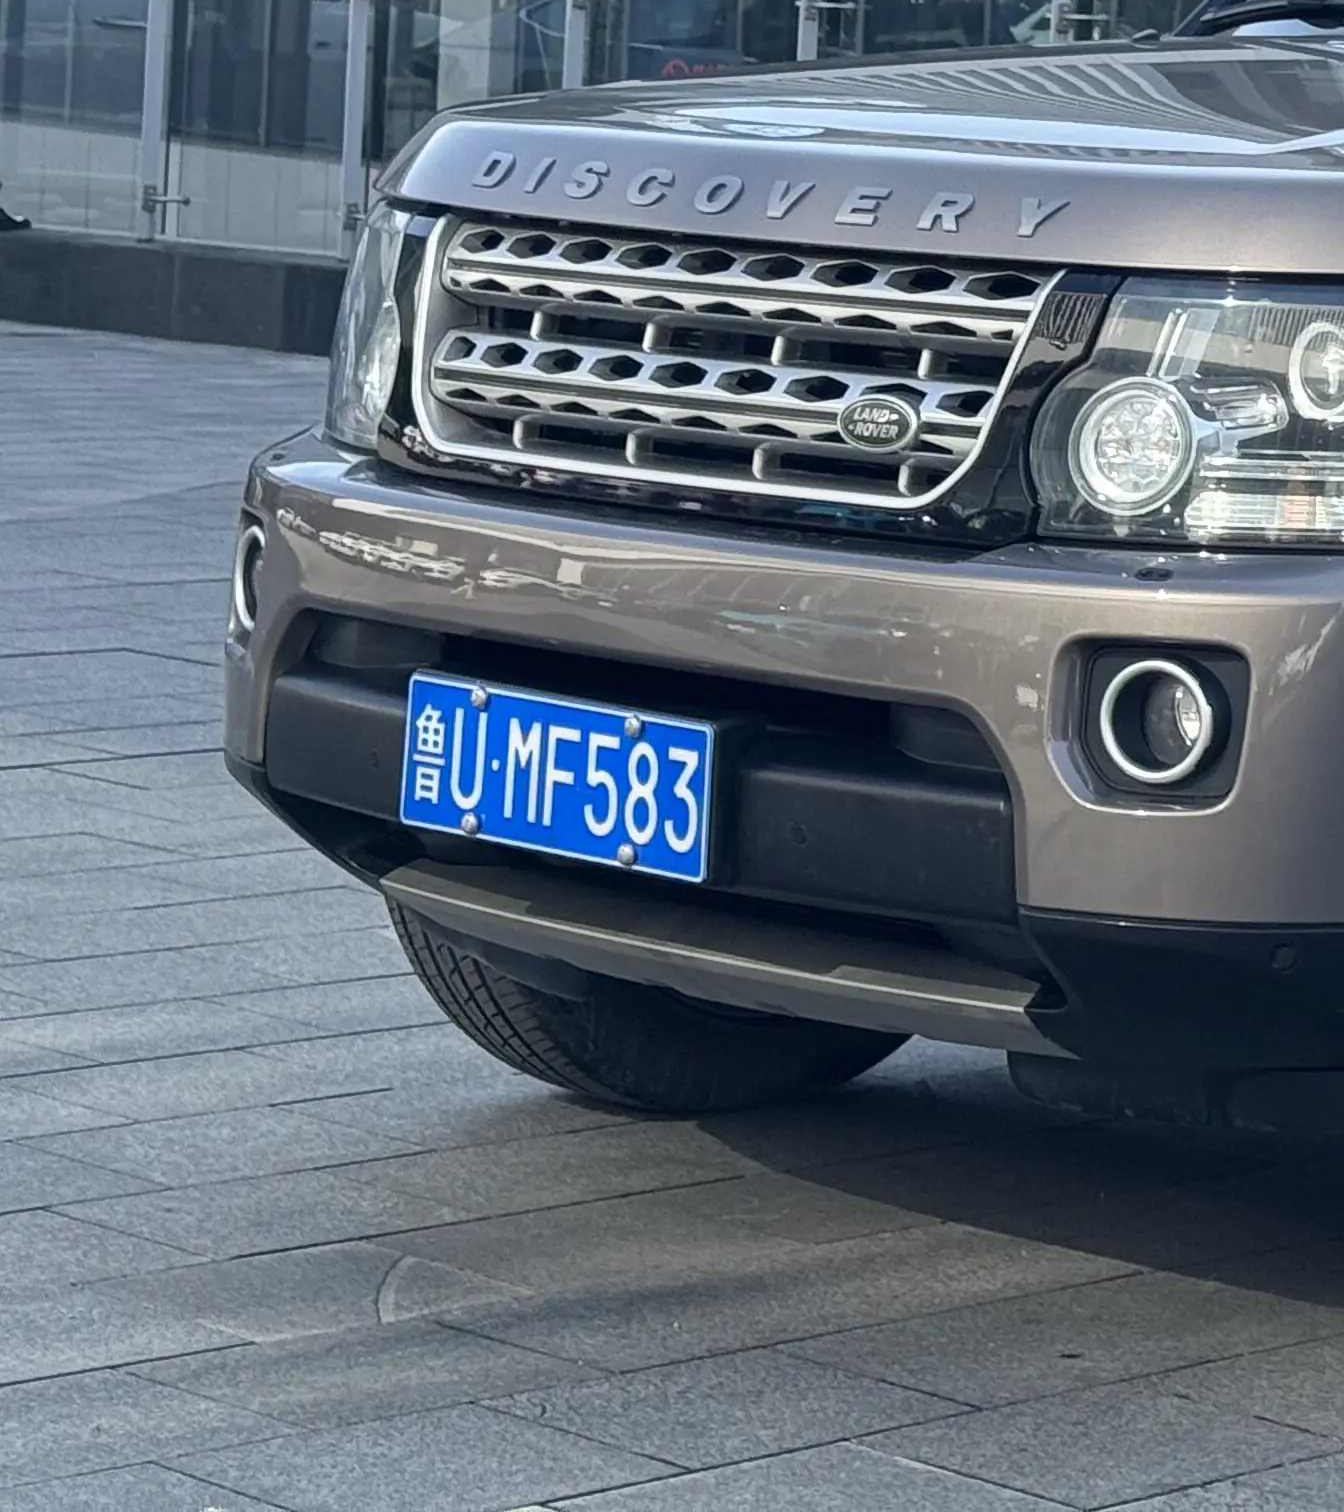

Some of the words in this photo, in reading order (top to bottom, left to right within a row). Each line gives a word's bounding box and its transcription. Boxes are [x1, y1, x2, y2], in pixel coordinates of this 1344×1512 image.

[471, 150, 1071, 238] DISCOVERY
[853, 407, 891, 423] LAND
[853, 422, 899, 440] ROVER
